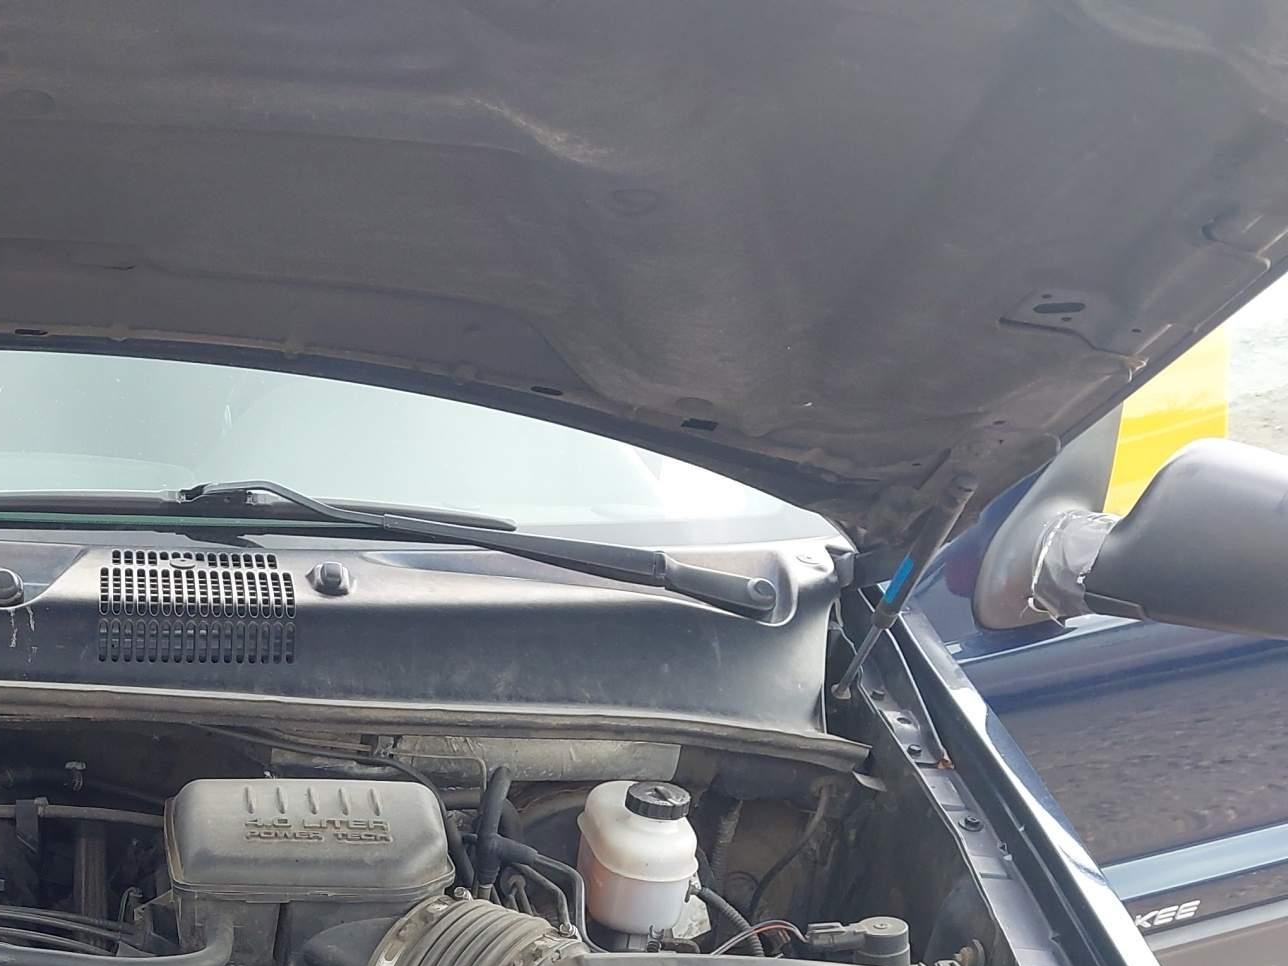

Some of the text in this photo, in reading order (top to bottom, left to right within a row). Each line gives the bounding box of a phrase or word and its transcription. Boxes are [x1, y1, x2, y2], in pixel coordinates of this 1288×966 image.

[245, 817, 390, 832] 4.0 LITER
[245, 830, 392, 842] POWER TECH
